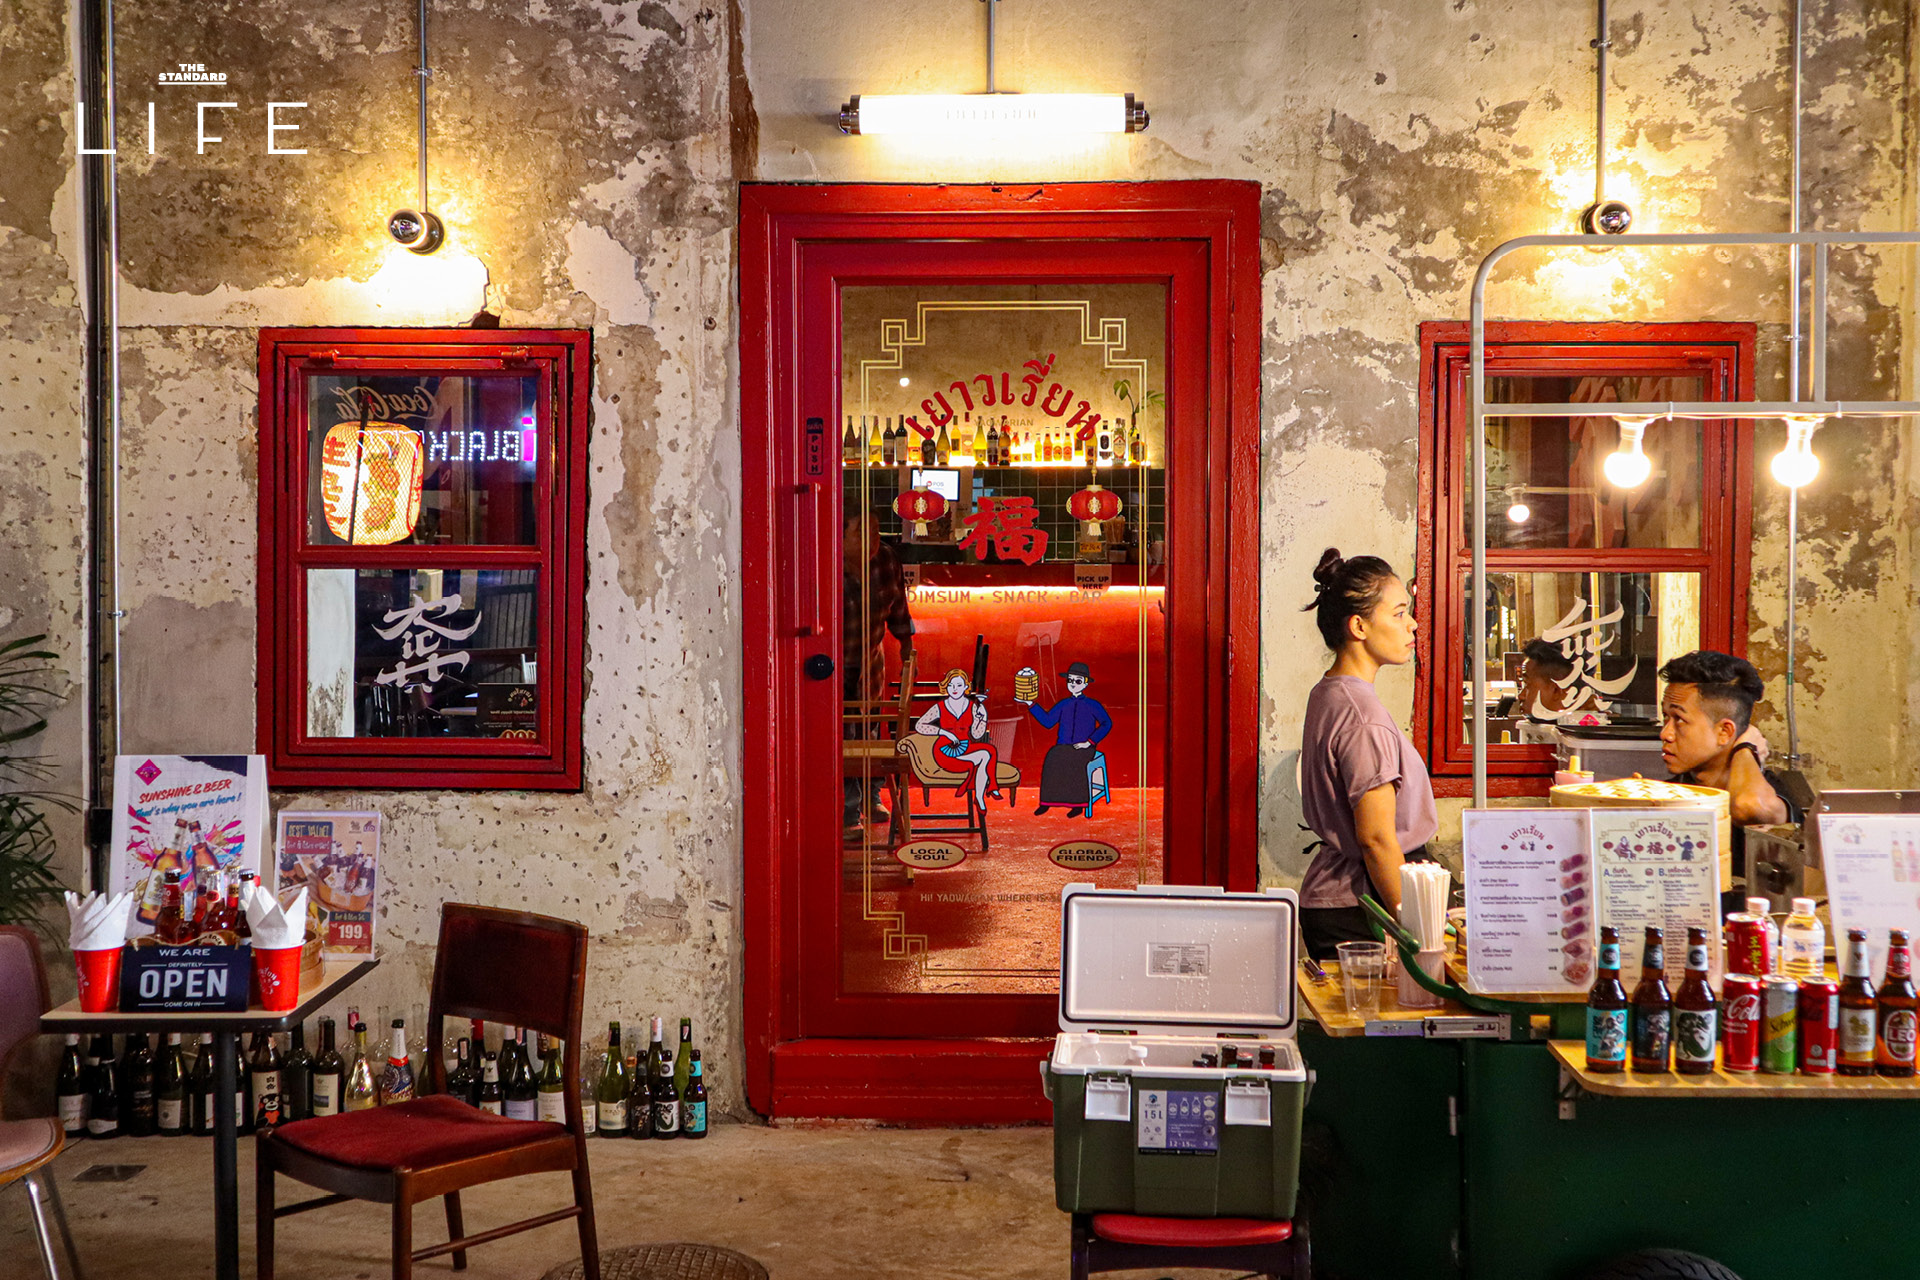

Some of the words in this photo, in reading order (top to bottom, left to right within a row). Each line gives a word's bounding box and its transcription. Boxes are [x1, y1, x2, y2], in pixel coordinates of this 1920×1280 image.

[959, 496, 1049, 567] 福
[1077, 575, 1096, 583] PICK
[1098, 575, 1109, 583] UP
[906, 590, 970, 603] DIMSUM
[992, 590, 1047, 603] SNACK
[1069, 590, 1101, 603] BAR
[138, 785, 194, 804] SUNSHINE
[203, 778, 232, 793] BEER
[180, 802, 198, 814] you
[1056, 854, 1113, 862] FRIENDS
[997, 893, 1032, 902] WHERE
[338, 924, 363, 939] 199
[158, 948, 179, 957] WE
[182, 948, 211, 956] ARE
[139, 969, 228, 999] OPEN
[1889, 1028, 1916, 1042] LEO
